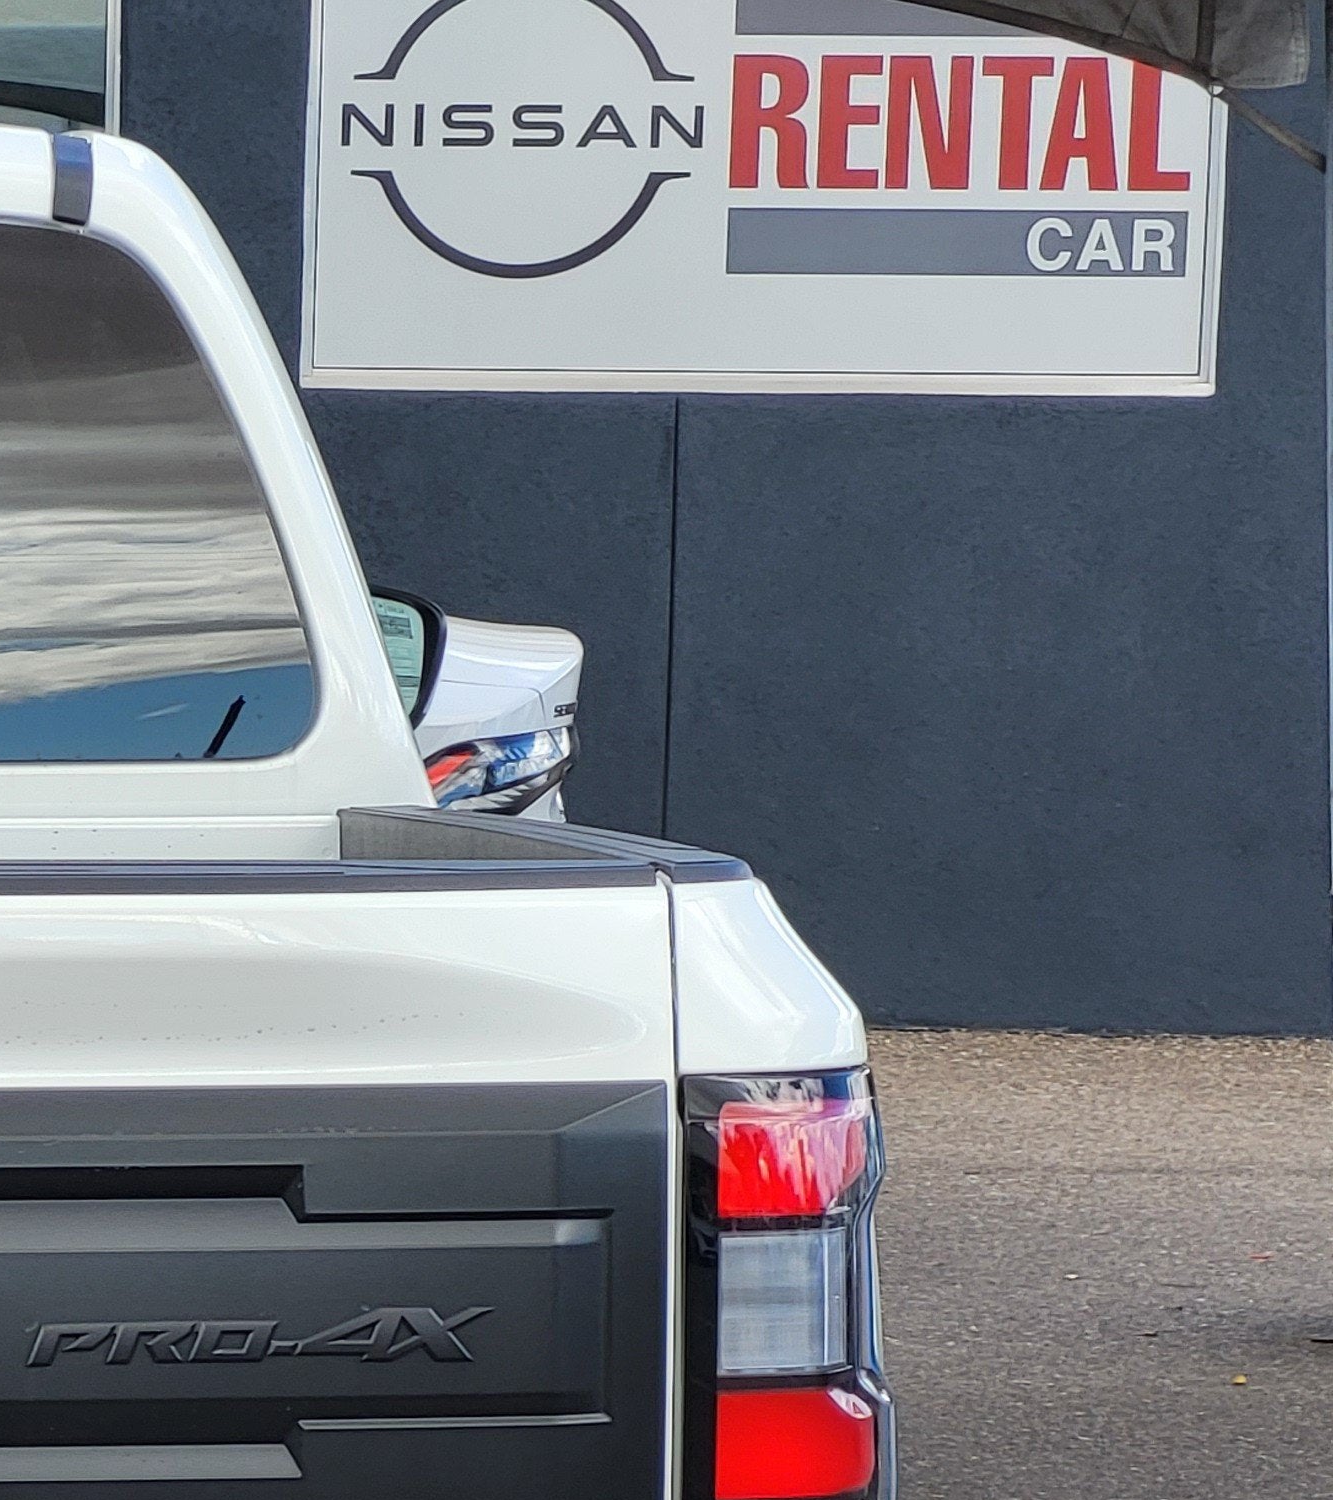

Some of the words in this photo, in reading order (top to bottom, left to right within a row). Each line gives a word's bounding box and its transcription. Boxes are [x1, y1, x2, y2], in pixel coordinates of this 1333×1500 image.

[340, 102, 706, 149] NISSAN
[728, 53, 1192, 192] RENTAL
[1026, 216, 1177, 273] CAR
[25, 1304, 497, 1368] PRO-4X
